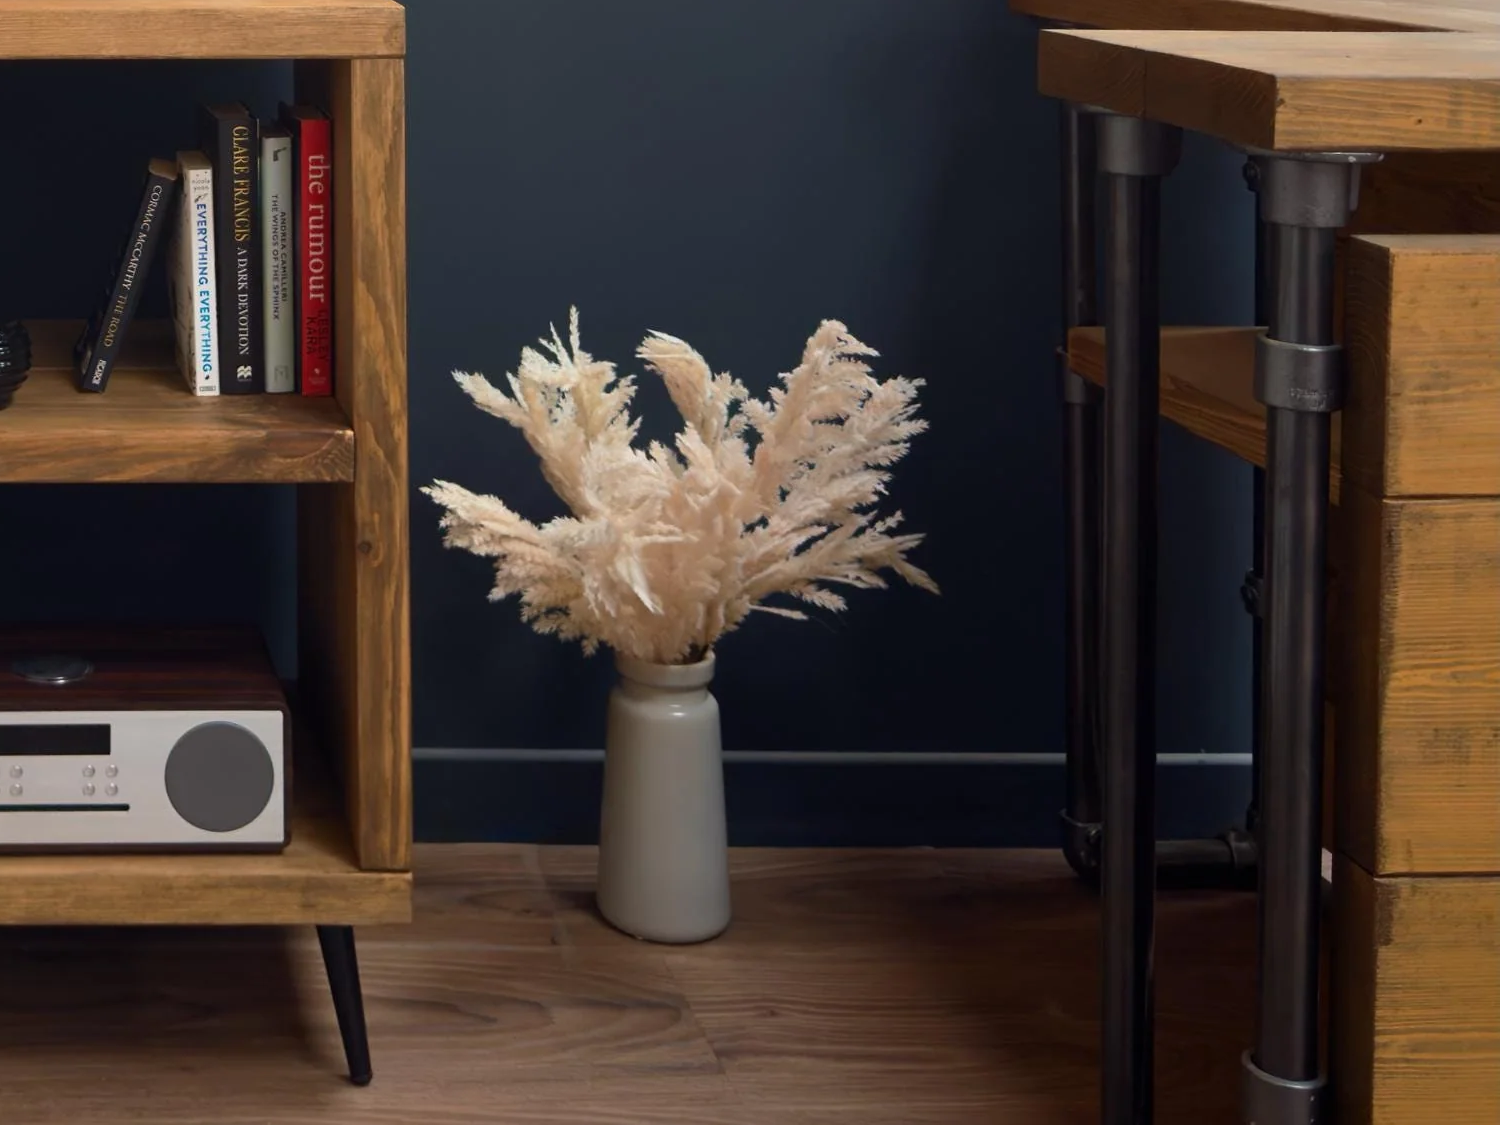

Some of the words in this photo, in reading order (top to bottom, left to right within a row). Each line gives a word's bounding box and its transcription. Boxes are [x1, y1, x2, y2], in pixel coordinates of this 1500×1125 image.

[232, 125, 250, 176] CLARE
[308, 154, 331, 195] the
[140, 184, 163, 233] CORMAC
[233, 179, 251, 243] FRANCIS
[271, 194, 279, 213] THE
[237, 246, 248, 256] A
[271, 214, 280, 248] WINGS
[280, 211, 288, 251] ANDREA
[237, 257, 249, 290] DARK
[272, 249, 280, 263] OF
[272, 264, 280, 282] THE
[308, 203, 326, 304] rumour
[280, 252, 289, 303] CAMILLERI
[113, 295, 128, 315] THE
[272, 284, 280, 321] SPHINX
[103, 317, 121, 347] ROAD
[199, 290, 213, 373] EVERYTHING
[237, 293, 250, 355] DEVOTION
[306, 315, 317, 355] KARA
